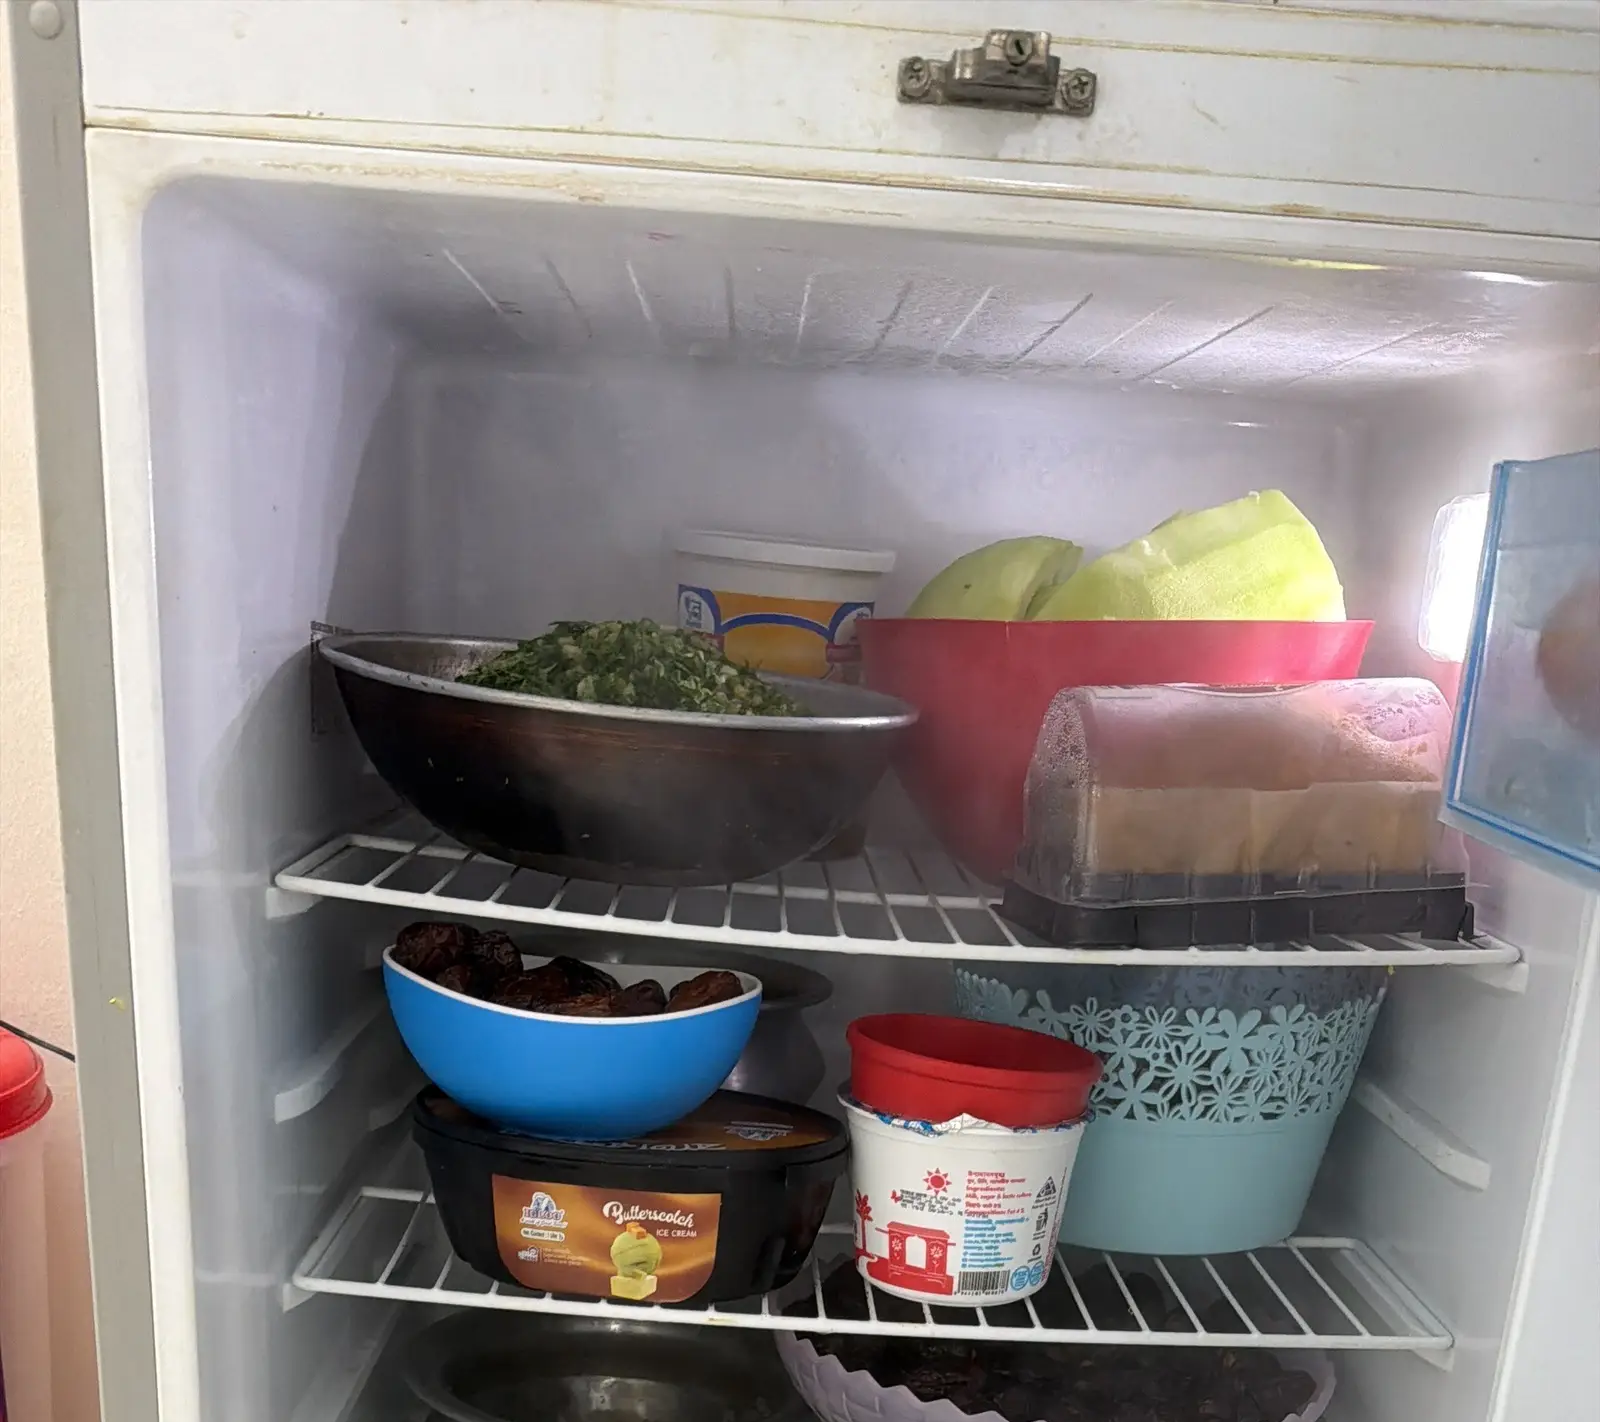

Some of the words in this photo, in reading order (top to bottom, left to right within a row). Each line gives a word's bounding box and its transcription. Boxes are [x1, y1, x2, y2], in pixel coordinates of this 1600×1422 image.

[603, 1201, 694, 1228] Butterscotch
[656, 1229, 669, 1237] ICE
[671, 1229, 697, 1238] CREAM
